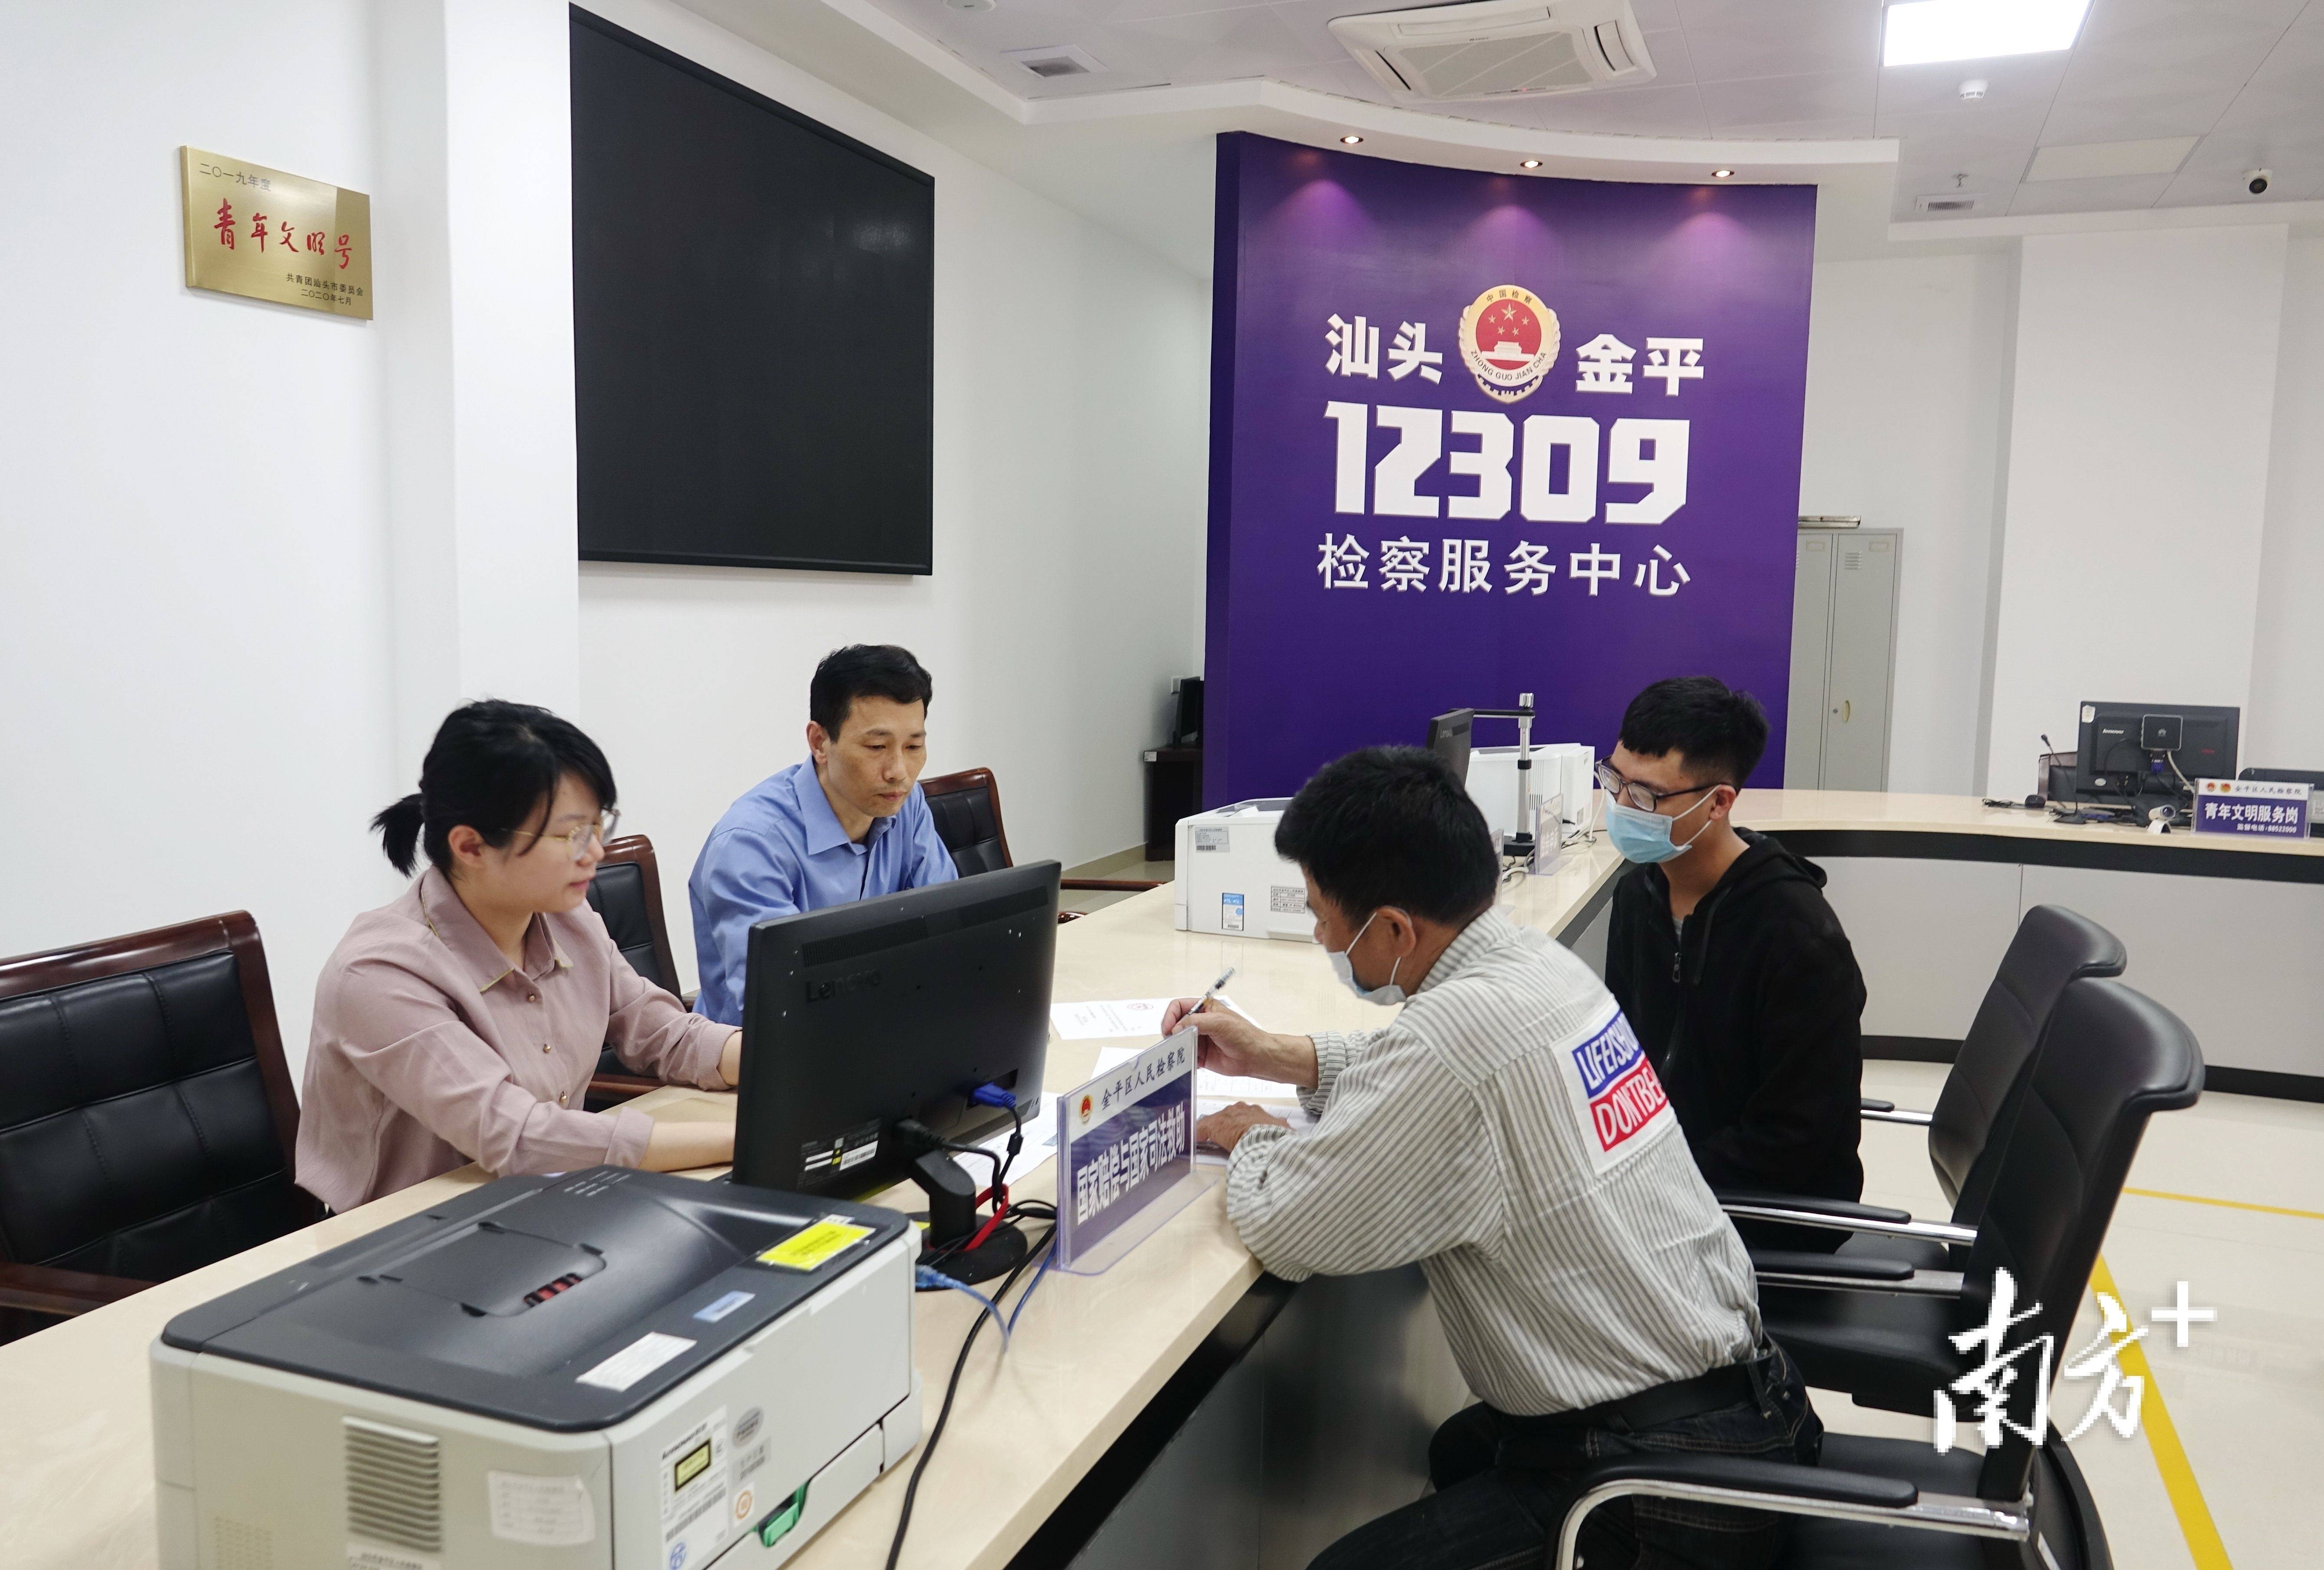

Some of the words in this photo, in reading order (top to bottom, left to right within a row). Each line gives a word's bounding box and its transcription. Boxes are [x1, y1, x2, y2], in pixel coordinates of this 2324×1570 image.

[214, 198, 353, 270] 青年文明号
[286, 273, 364, 297] 共青团汕头市委员会
[1487, 290, 1533, 304] 中国检察
[1324, 313, 1444, 384] 汕头
[1575, 333, 1705, 396] 金平
[1471, 349, 1494, 376] ZHONG
[1495, 371, 1513, 381] GUO
[1516, 368, 1533, 381] JIAN
[1533, 352, 1546, 369] CHA
[1324, 400, 1690, 524] 12309
[1317, 532, 1690, 597] 检察服务中心
[2205, 802, 2298, 824] 青年文明服务岗
[2235, 785, 2302, 795] 金平区人民检察院
[1101, 1046, 1186, 1111] 金平区人民检察院
[1077, 1101, 1185, 1226] 国家赔偿与国家司法救助
